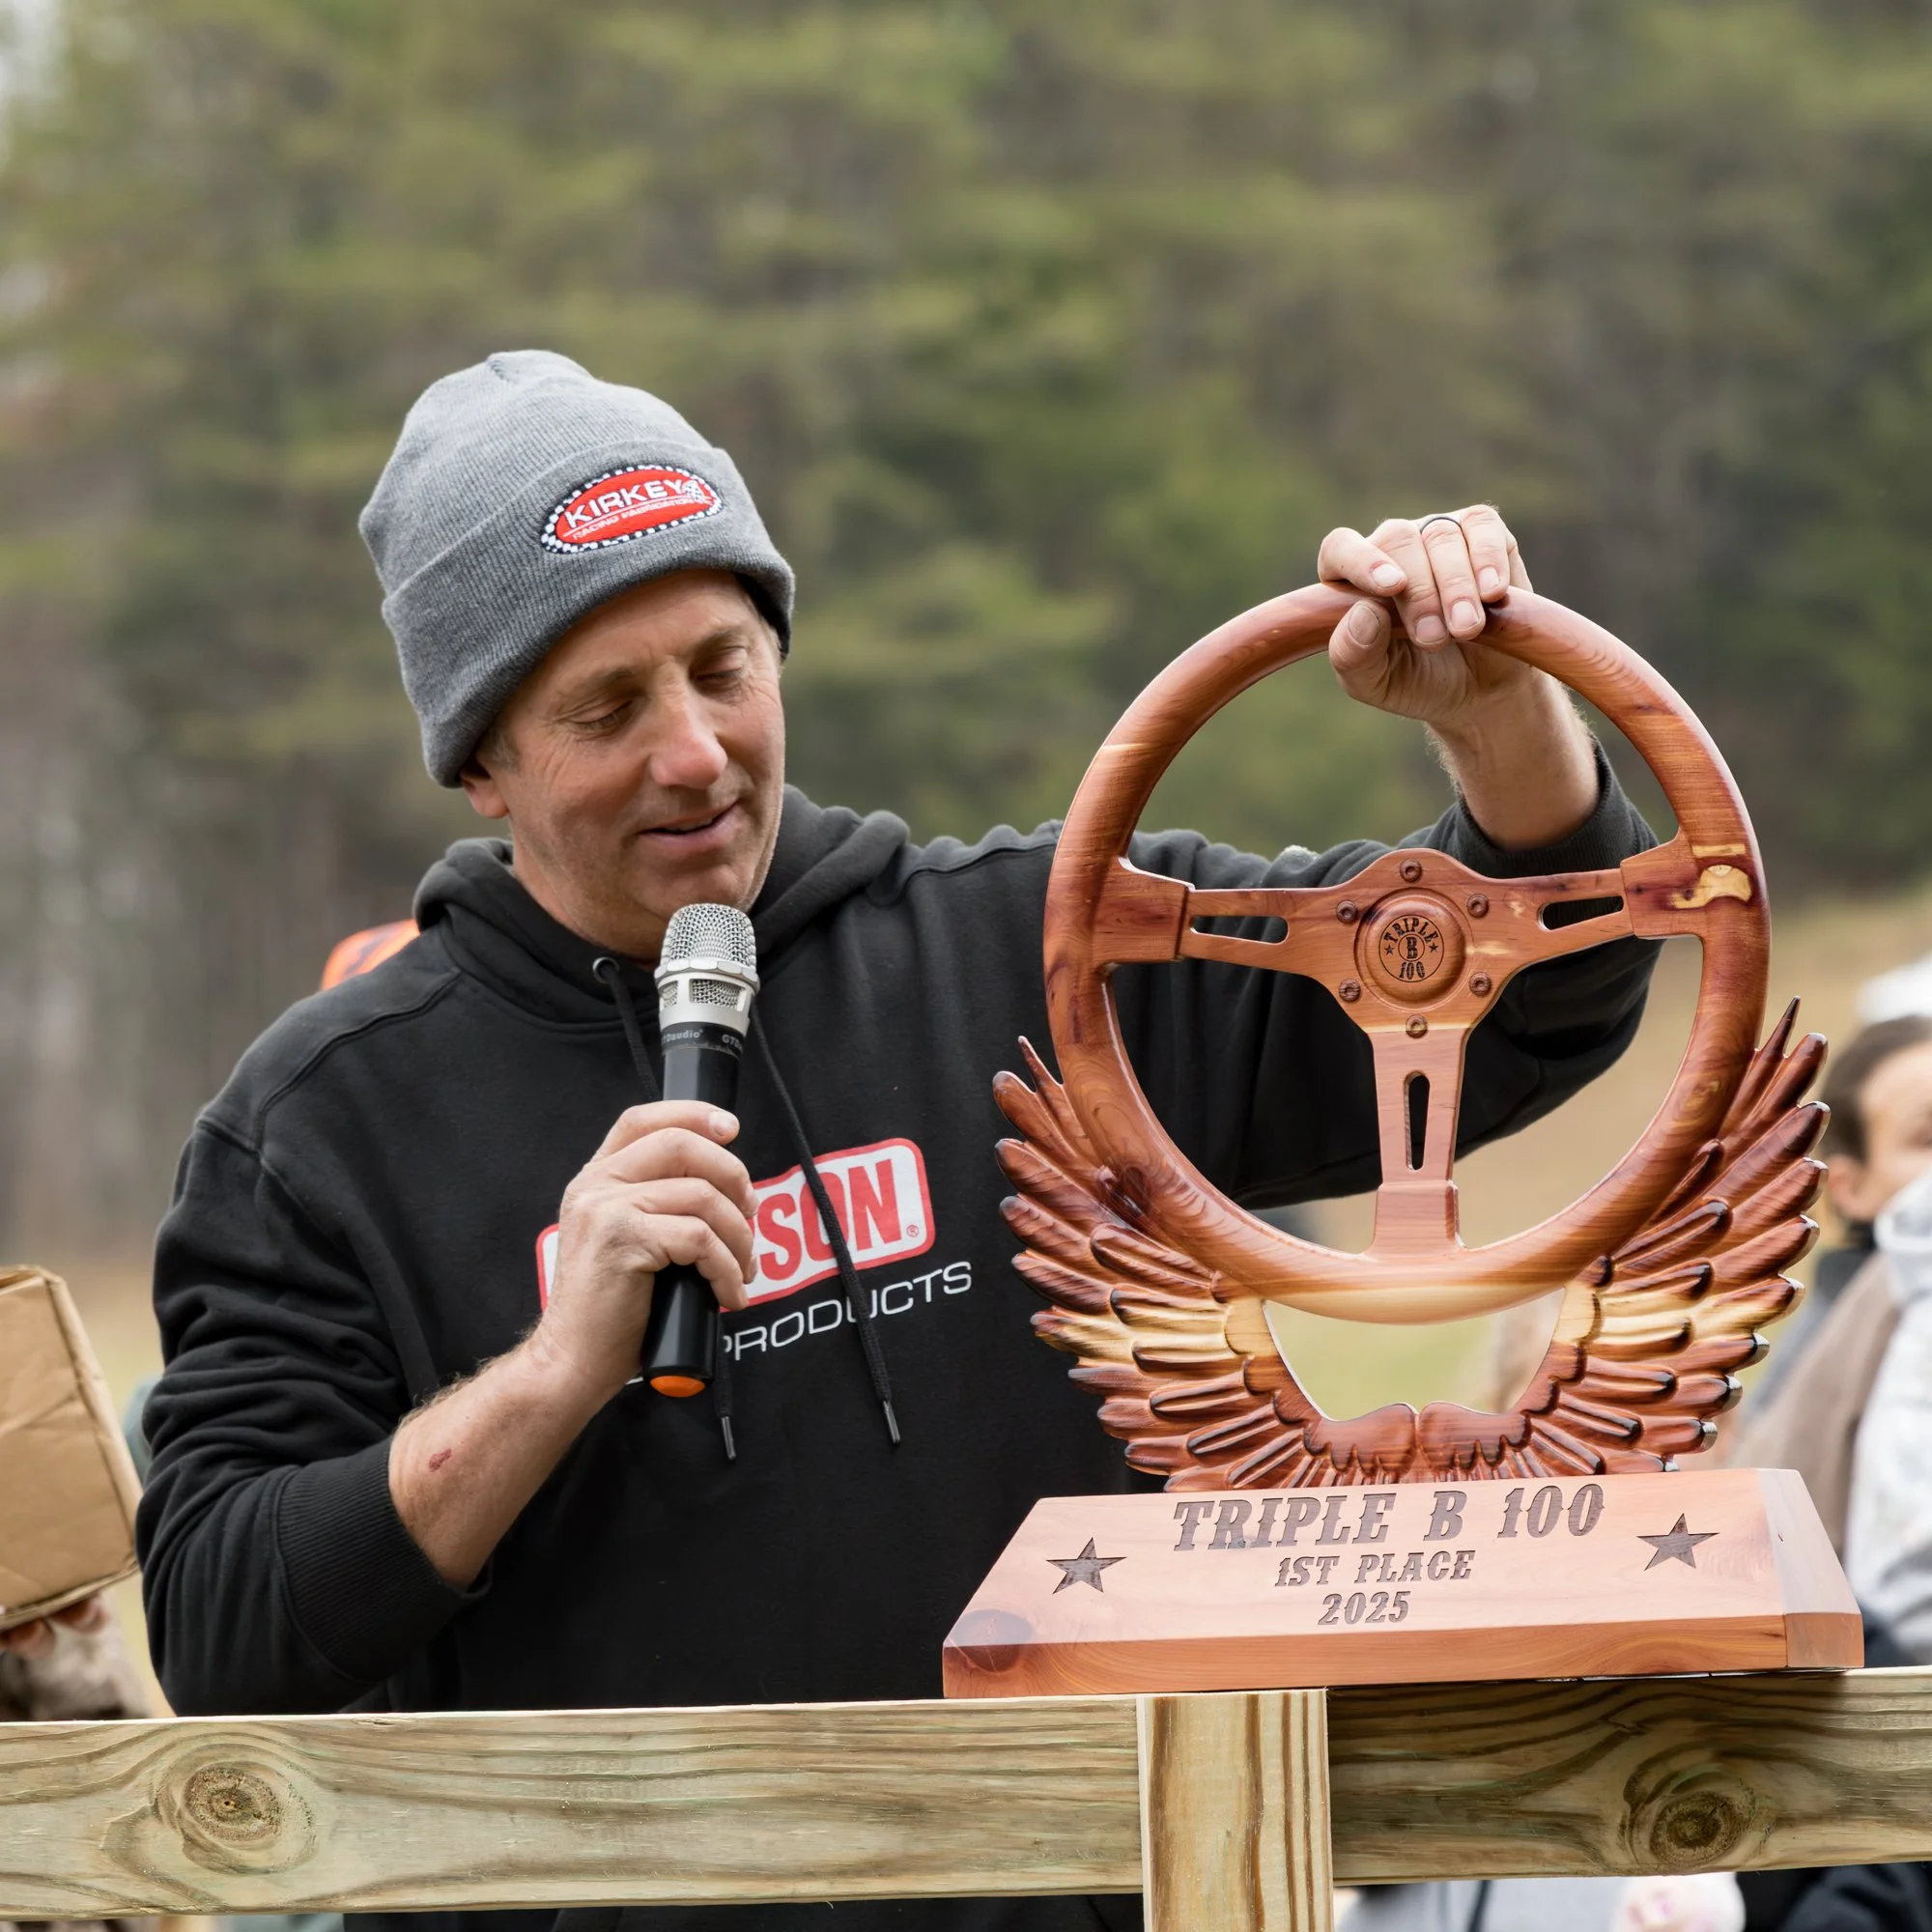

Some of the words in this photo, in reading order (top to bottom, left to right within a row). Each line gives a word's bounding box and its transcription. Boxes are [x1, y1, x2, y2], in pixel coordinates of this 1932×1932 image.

[564, 479, 683, 528] KIRKEY
[1383, 917, 1438, 944] TRIPLE
[1406, 936, 1418, 959] B
[1399, 960, 1425, 980] 100
[1173, 1492, 1397, 1551] TRIPLE
[1423, 1490, 1468, 1542] B
[1496, 1483, 1606, 1539] 100
[1274, 1556, 1339, 1587] 1ST
[1354, 1549, 1476, 1584] PLACE
[1318, 1590, 1411, 1626] 2025
